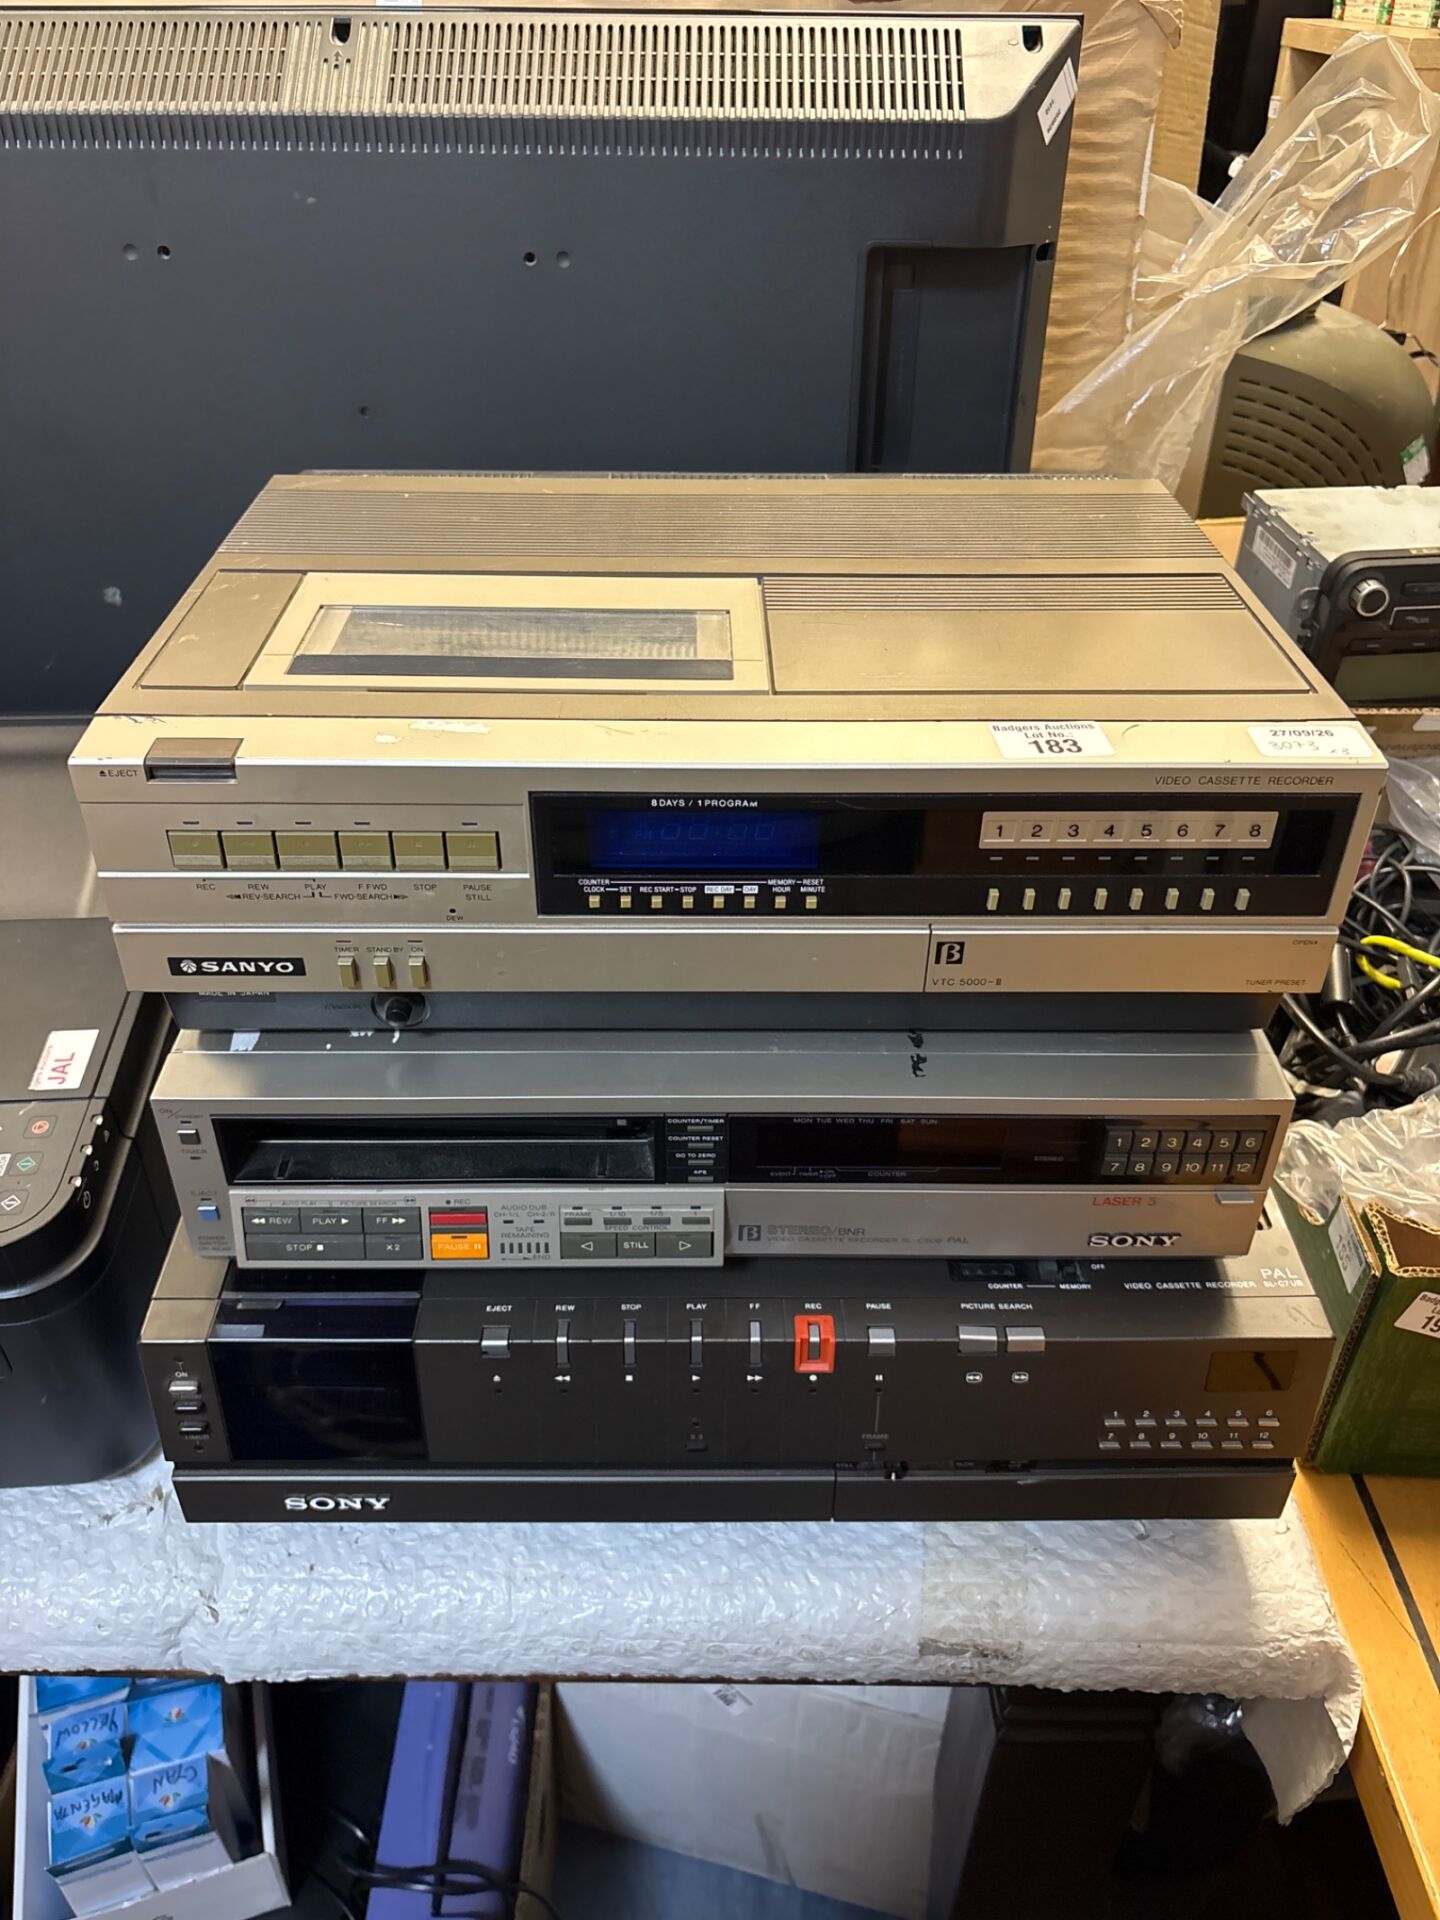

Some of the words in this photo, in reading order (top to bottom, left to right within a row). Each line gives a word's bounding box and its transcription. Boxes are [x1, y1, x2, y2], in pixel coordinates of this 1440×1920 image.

[991, 722, 1041, 734] Badgers
[1044, 722, 1096, 733] Auctions
[1268, 728, 1335, 738] 27/09/26
[1024, 731, 1044, 740] Lot
[1027, 738, 1083, 756] 183
[107, 768, 139, 778] EJECT
[1154, 775, 1192, 786] VIDEO
[1198, 775, 1262, 786] CASSETTE
[1267, 775, 1335, 786] RECORDER
[704, 799, 758, 807] PROGRAM
[995, 824, 1003, 838] 1
[1031, 824, 1043, 838] 2
[1067, 824, 1079, 838] 3
[1103, 824, 1116, 838] 4
[1140, 824, 1153, 838] 5
[1177, 824, 1189, 838] 6
[1214, 824, 1226, 838] 7
[1249, 824, 1261, 838] 8
[195, 882, 217, 892] REC
[247, 882, 270, 891] REW
[304, 882, 327, 892] PLAY
[578, 878, 610, 886] COUNTER
[767, 878, 797, 886] MEMORY
[802, 878, 824, 886] RESET
[413, 883, 438, 892] STOP
[462, 883, 493, 892] PAUSE
[464, 893, 492, 902] STILL
[445, 914, 464, 922] DEW
[333, 946, 360, 954] TIMER
[410, 946, 425, 954] ON
[200, 959, 296, 975] SANYO
[931, 977, 957, 987] VTC
[1244, 978, 1272, 987] TUNER
[1274, 978, 1306, 987] PRESET
[47, 1052, 76, 1085] JAL
[667, 1117, 726, 1125] COUNTER/TIMER
[793, 1117, 814, 1125] MON
[816, 1117, 833, 1125] TUE
[835, 1117, 856, 1125] WED
[858, 1117, 875, 1125] THU
[1116, 1137, 1123, 1148] 1
[1140, 1137, 1152, 1148] 2
[1166, 1137, 1178, 1148] 3
[1191, 1137, 1204, 1148] 4
[1218, 1137, 1230, 1148] 5
[1244, 1137, 1257, 1148] 6
[1110, 1162, 1120, 1173] 7
[1134, 1162, 1146, 1173] 8
[1161, 1162, 1172, 1173] 9
[1185, 1162, 1200, 1173] 10
[1211, 1162, 1224, 1173] 11
[1236, 1162, 1252, 1173] 12
[453, 1198, 472, 1206] REC
[1092, 1196, 1143, 1207] LASER
[500, 1204, 528, 1212] AUDIO
[529, 1204, 548, 1212] DUB
[268, 1216, 293, 1225] REW
[312, 1216, 337, 1225] PLAY
[375, 1217, 388, 1225] FF
[623, 1241, 649, 1249] STILL
[1089, 1234, 1181, 1248] SONY
[285, 1244, 314, 1252] STOP
[437, 1242, 471, 1251] PAUSE
[1260, 1267, 1299, 1280] PAL
[1059, 1283, 1092, 1291] MEMORY
[1124, 1281, 1153, 1290] VIDEO
[1156, 1281, 1202, 1290] CASSETTE
[1205, 1280, 1258, 1290] RECORDER
[486, 1304, 512, 1313] EJECT
[555, 1304, 575, 1312] REW
[620, 1303, 642, 1311] STOP
[686, 1303, 708, 1311] PLAY
[804, 1302, 823, 1310] REC
[865, 1302, 892, 1310] PAUSE
[960, 1302, 996, 1311] PICTURE
[998, 1303, 1034, 1311] SEARCH
[284, 1495, 391, 1511] SONY
[55, 1708, 119, 1747] YELLOW
[152, 1763, 198, 1794] CYAN
[54, 1788, 123, 1821] MAGENTA
